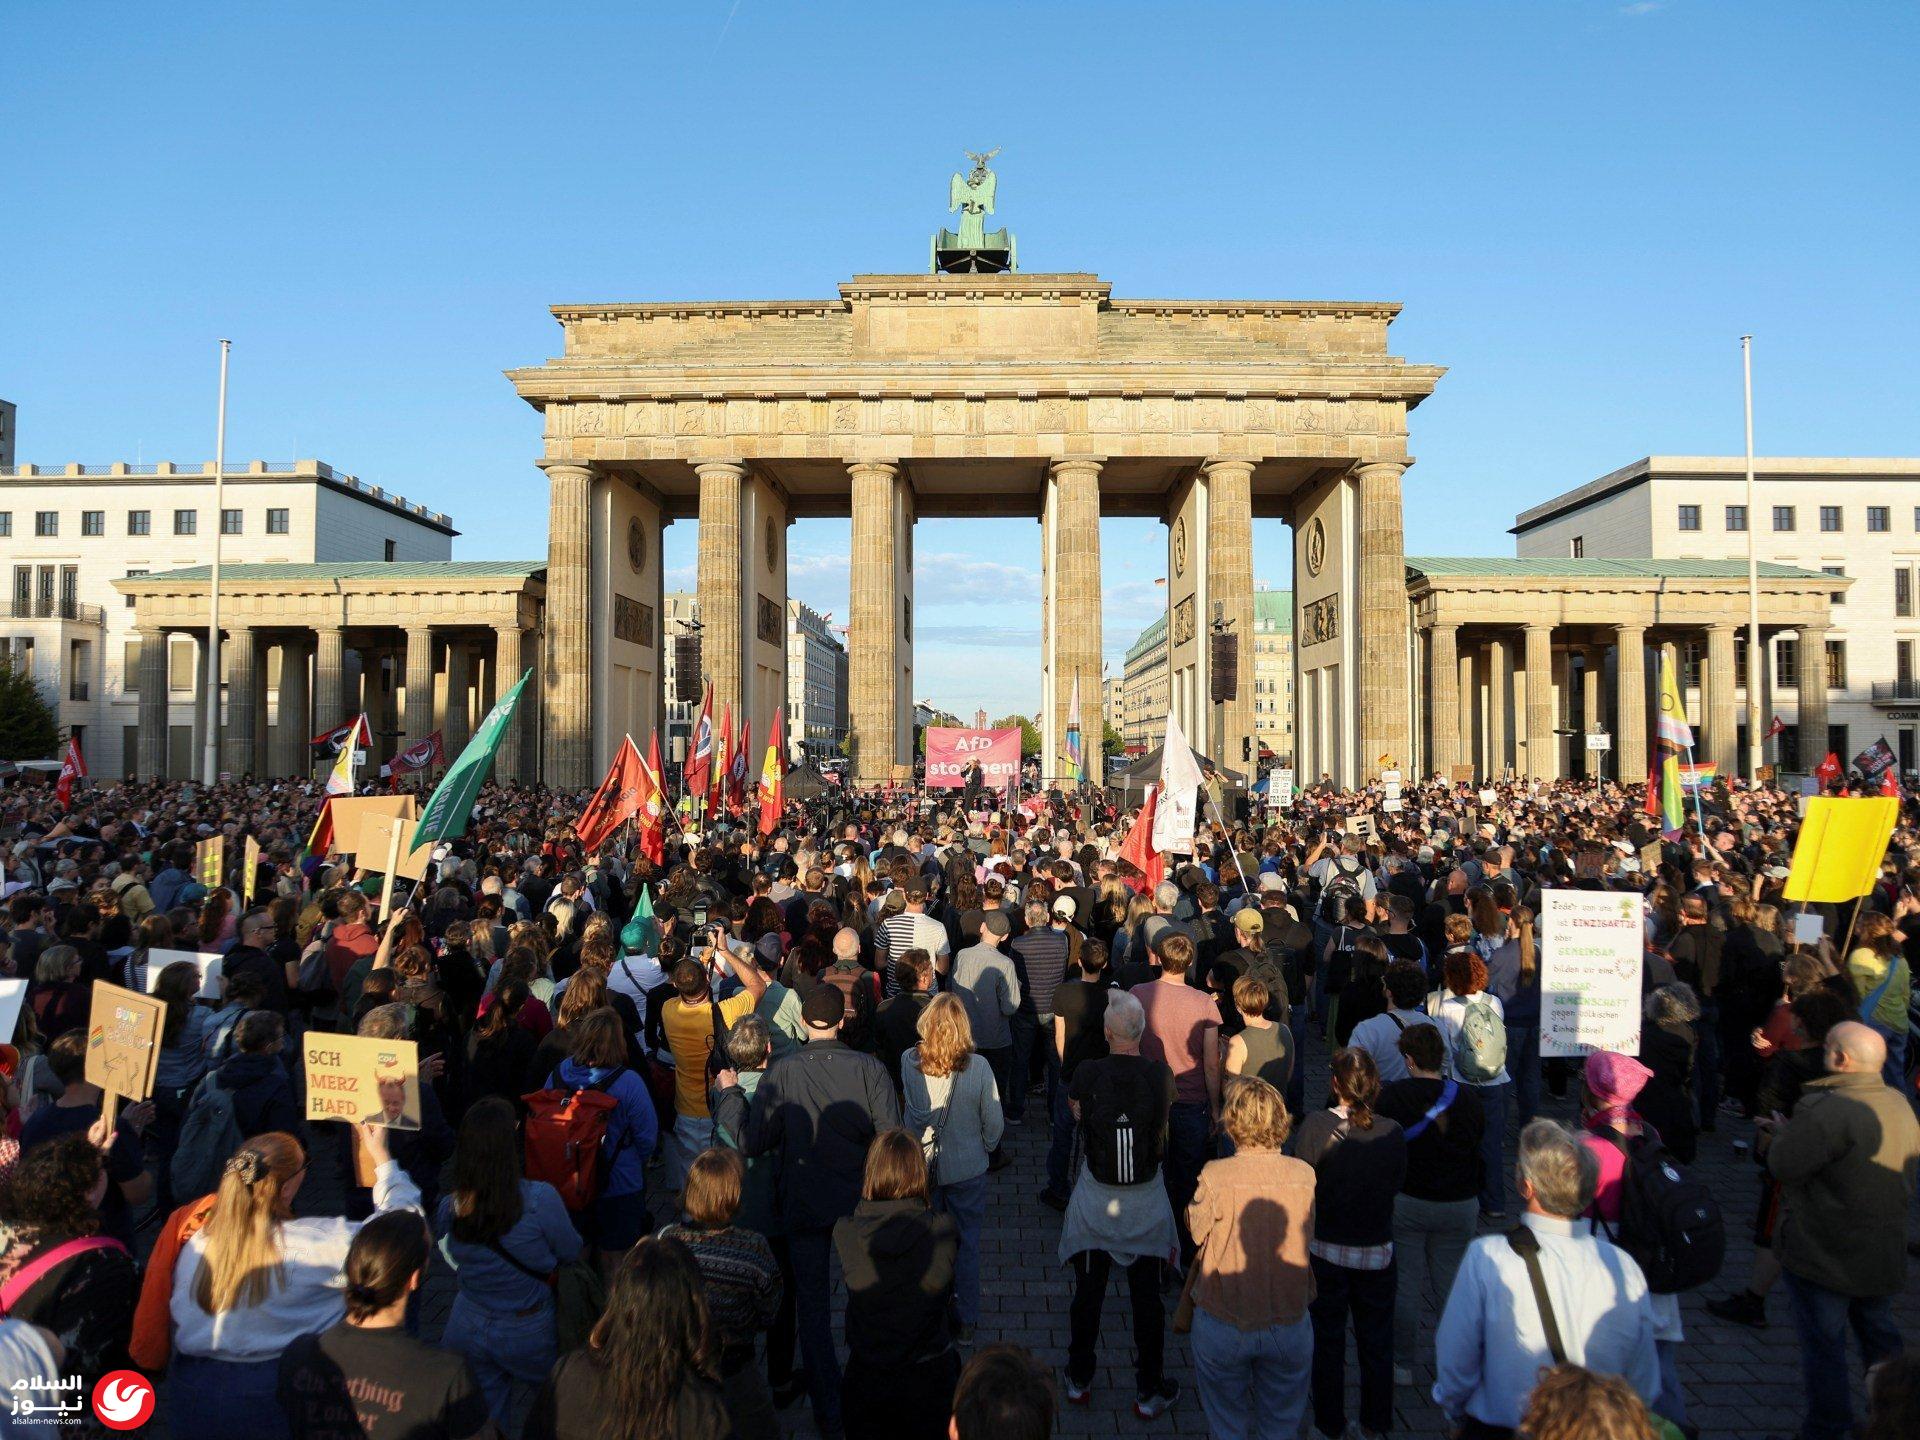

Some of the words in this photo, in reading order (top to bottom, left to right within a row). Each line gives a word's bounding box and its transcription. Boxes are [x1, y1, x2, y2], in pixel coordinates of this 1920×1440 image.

[954, 736, 993, 752] AfD
[930, 760, 1019, 776] stopen!
[1572, 918, 1637, 929] EINZIGARTIG
[1558, 947, 1616, 957] GEMEINSAM
[1551, 1009, 1576, 1021] gegen
[308, 1050, 341, 1067] SCH
[310, 1073, 358, 1092] MERZ
[312, 1097, 357, 1115] HAFD
[292, 1366, 405, 1413] Eveything
